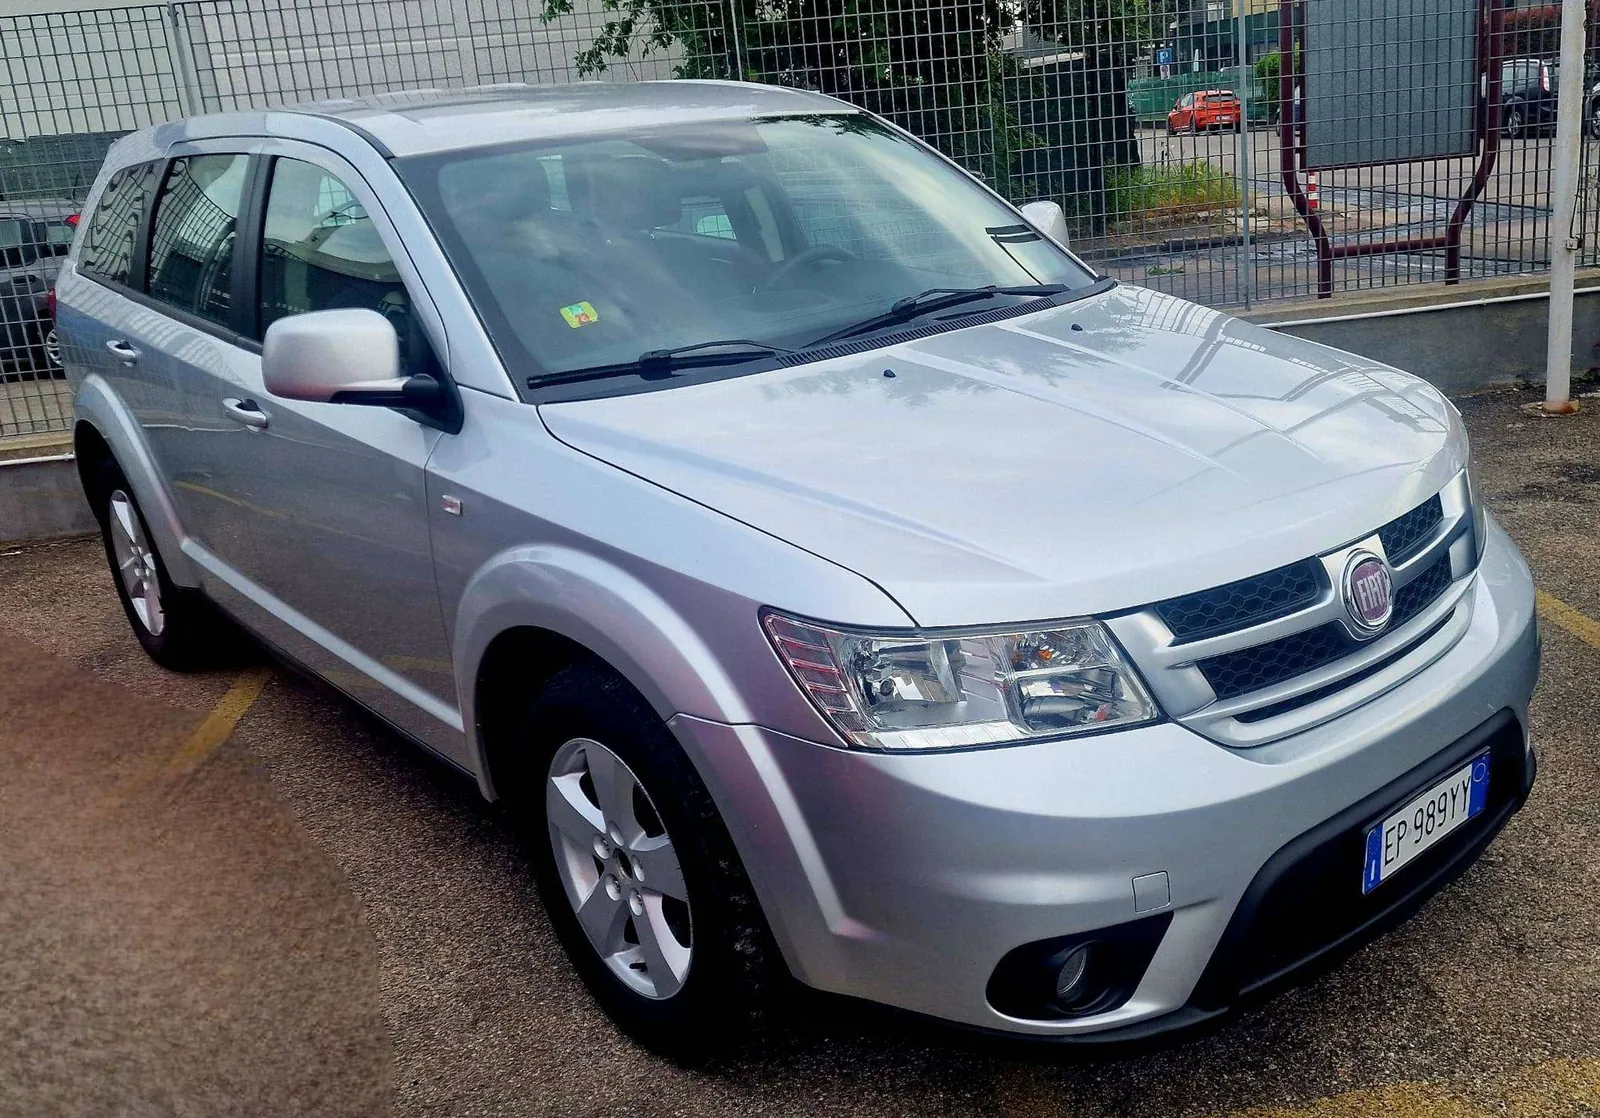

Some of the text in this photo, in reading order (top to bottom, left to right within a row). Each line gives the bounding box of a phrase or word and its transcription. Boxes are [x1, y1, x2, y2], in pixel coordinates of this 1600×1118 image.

[1356, 571, 1386, 612] FIAT
[1384, 820, 1408, 867] EP
[1413, 775, 1472, 844] 989YY
